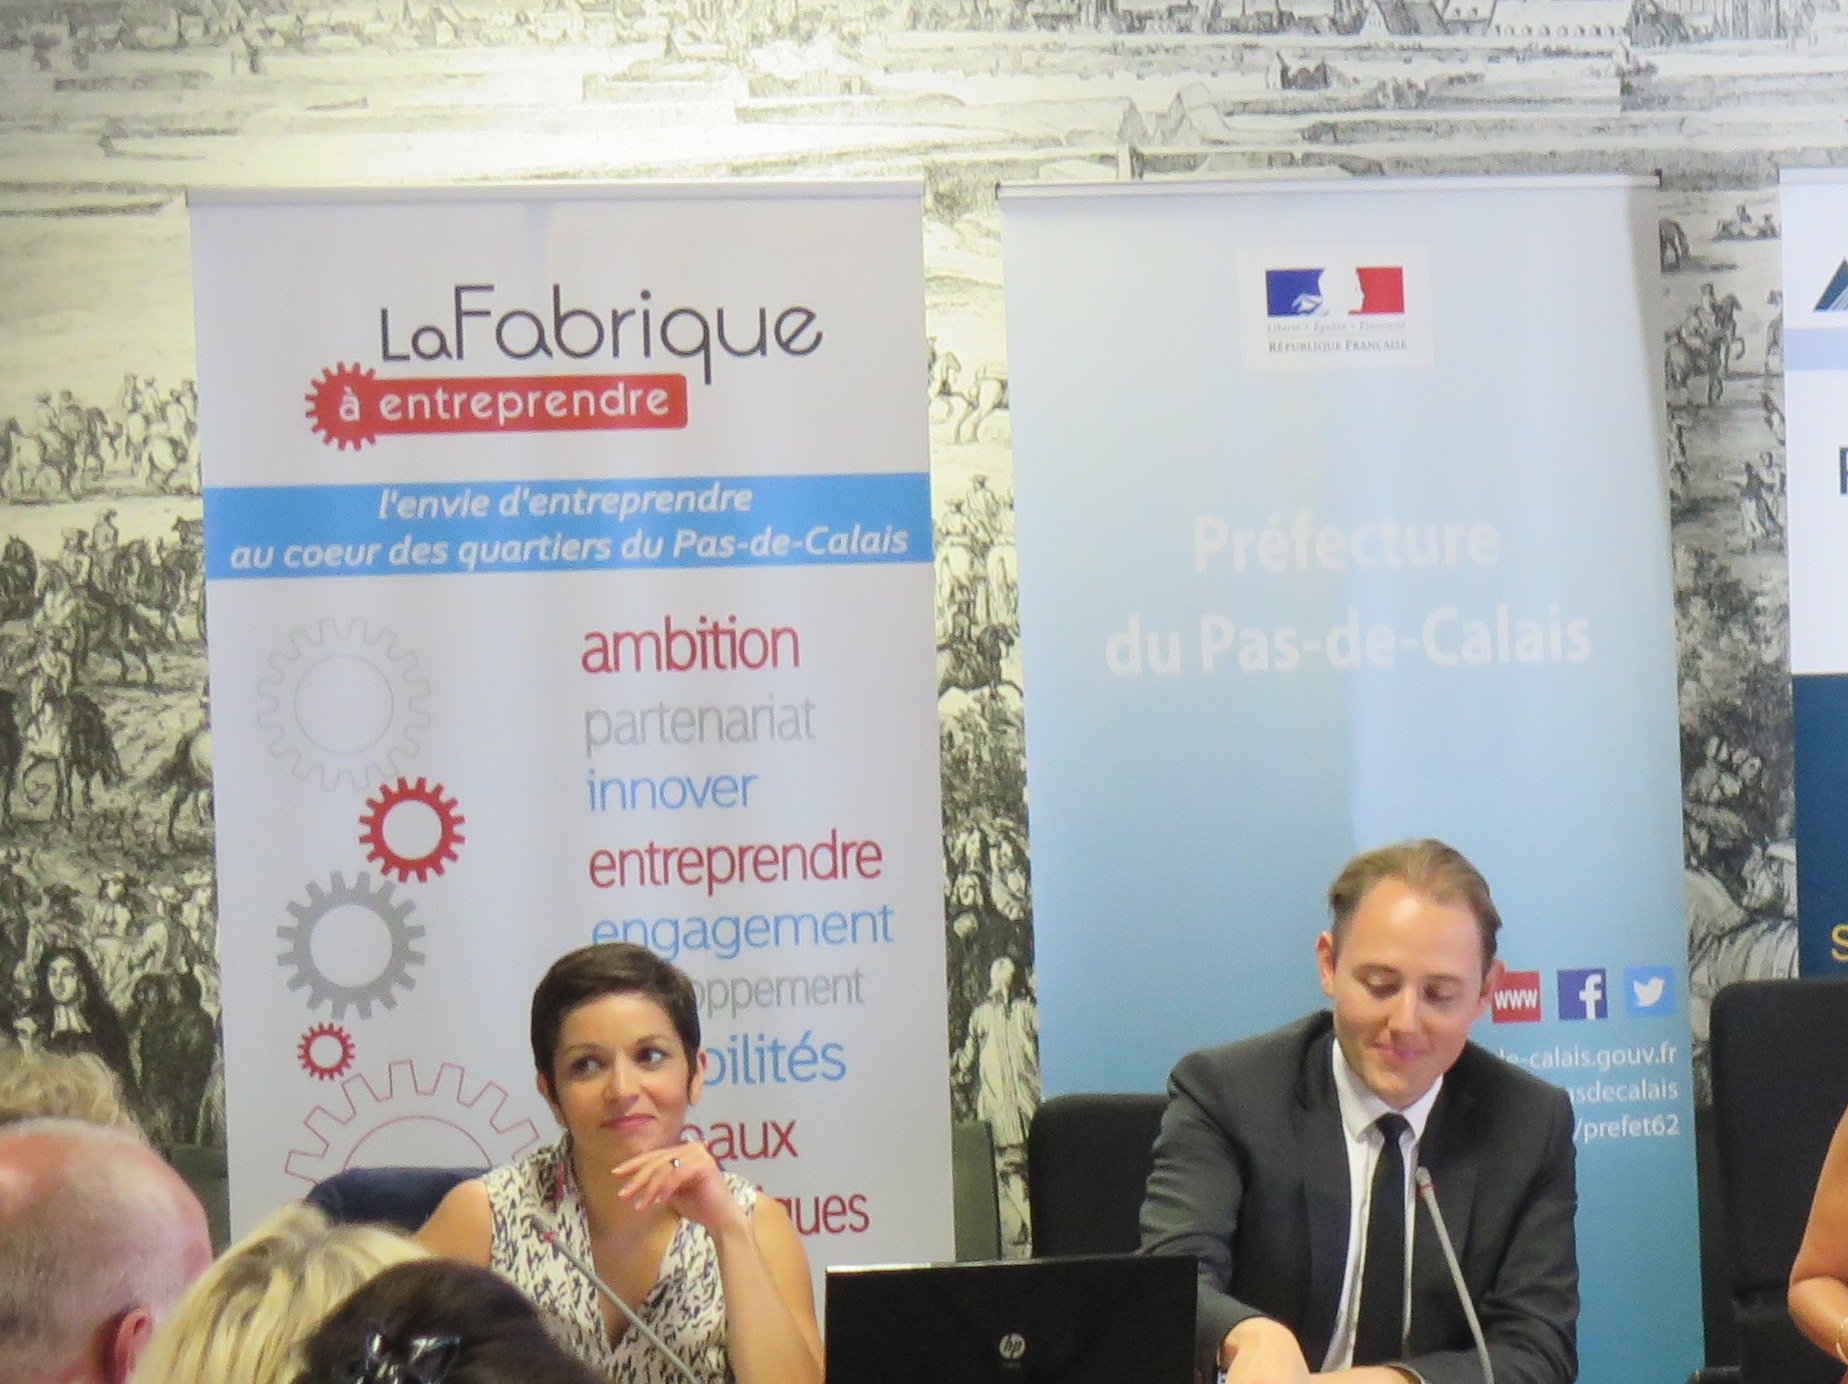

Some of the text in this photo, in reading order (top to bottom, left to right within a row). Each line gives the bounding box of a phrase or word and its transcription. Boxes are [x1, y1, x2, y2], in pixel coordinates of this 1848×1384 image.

[338, 379, 670, 427] à entreprendre
[377, 482, 753, 524] l'envie d'entreprendre
[229, 524, 909, 572] au coeur des quartiers du Pas-de-Calais
[1194, 508, 1500, 574] Préfecture
[581, 615, 800, 675] ambition
[1105, 602, 1593, 676] du Pas-de-Calais
[584, 694, 816, 759] partenariat
[587, 768, 757, 813] innover
[588, 829, 883, 897] entreprendre
[592, 904, 895, 959] engagement
